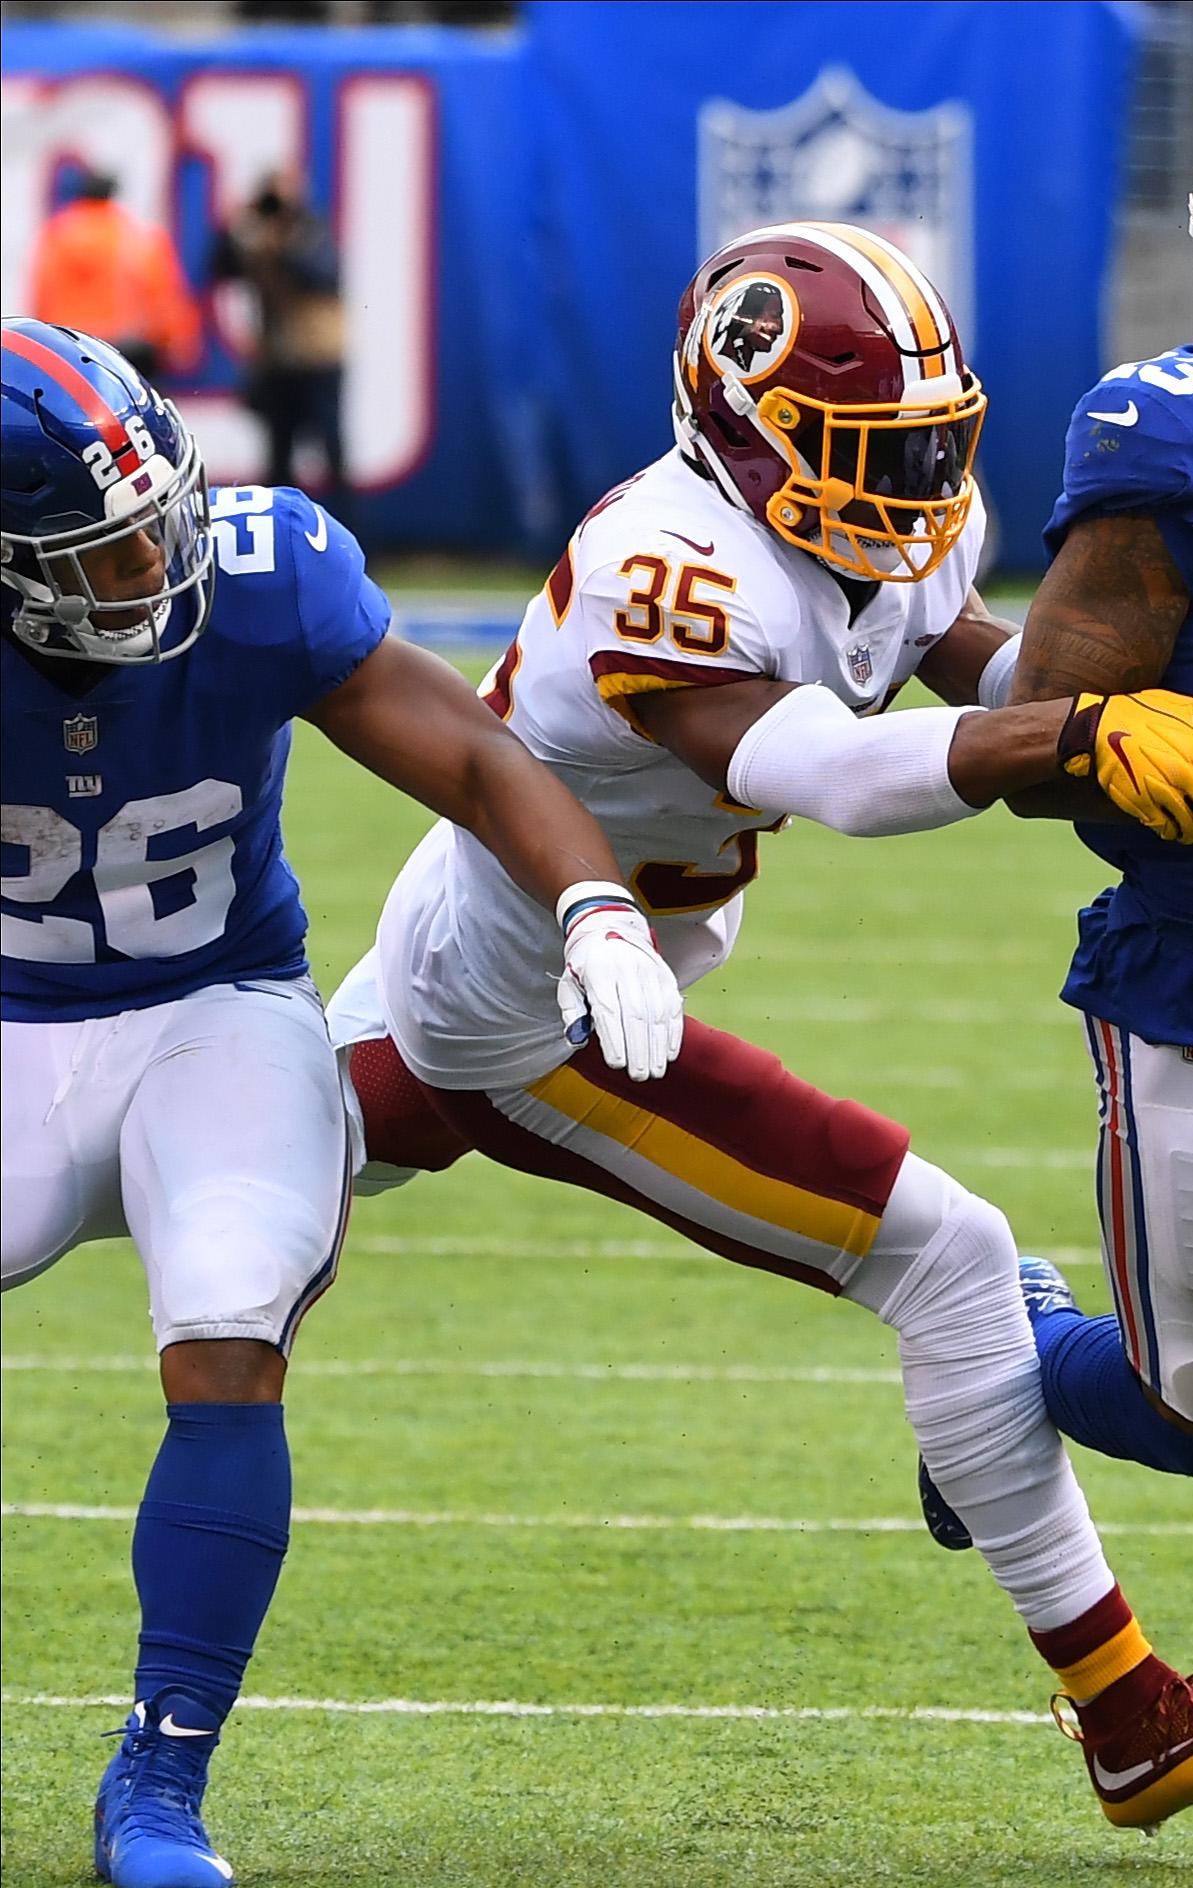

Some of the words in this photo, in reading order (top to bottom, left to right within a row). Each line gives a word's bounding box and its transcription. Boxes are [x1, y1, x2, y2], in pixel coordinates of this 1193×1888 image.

[82, 415, 155, 490] 26
[613, 553, 738, 657] 35
[0, 778, 243, 963] 26
